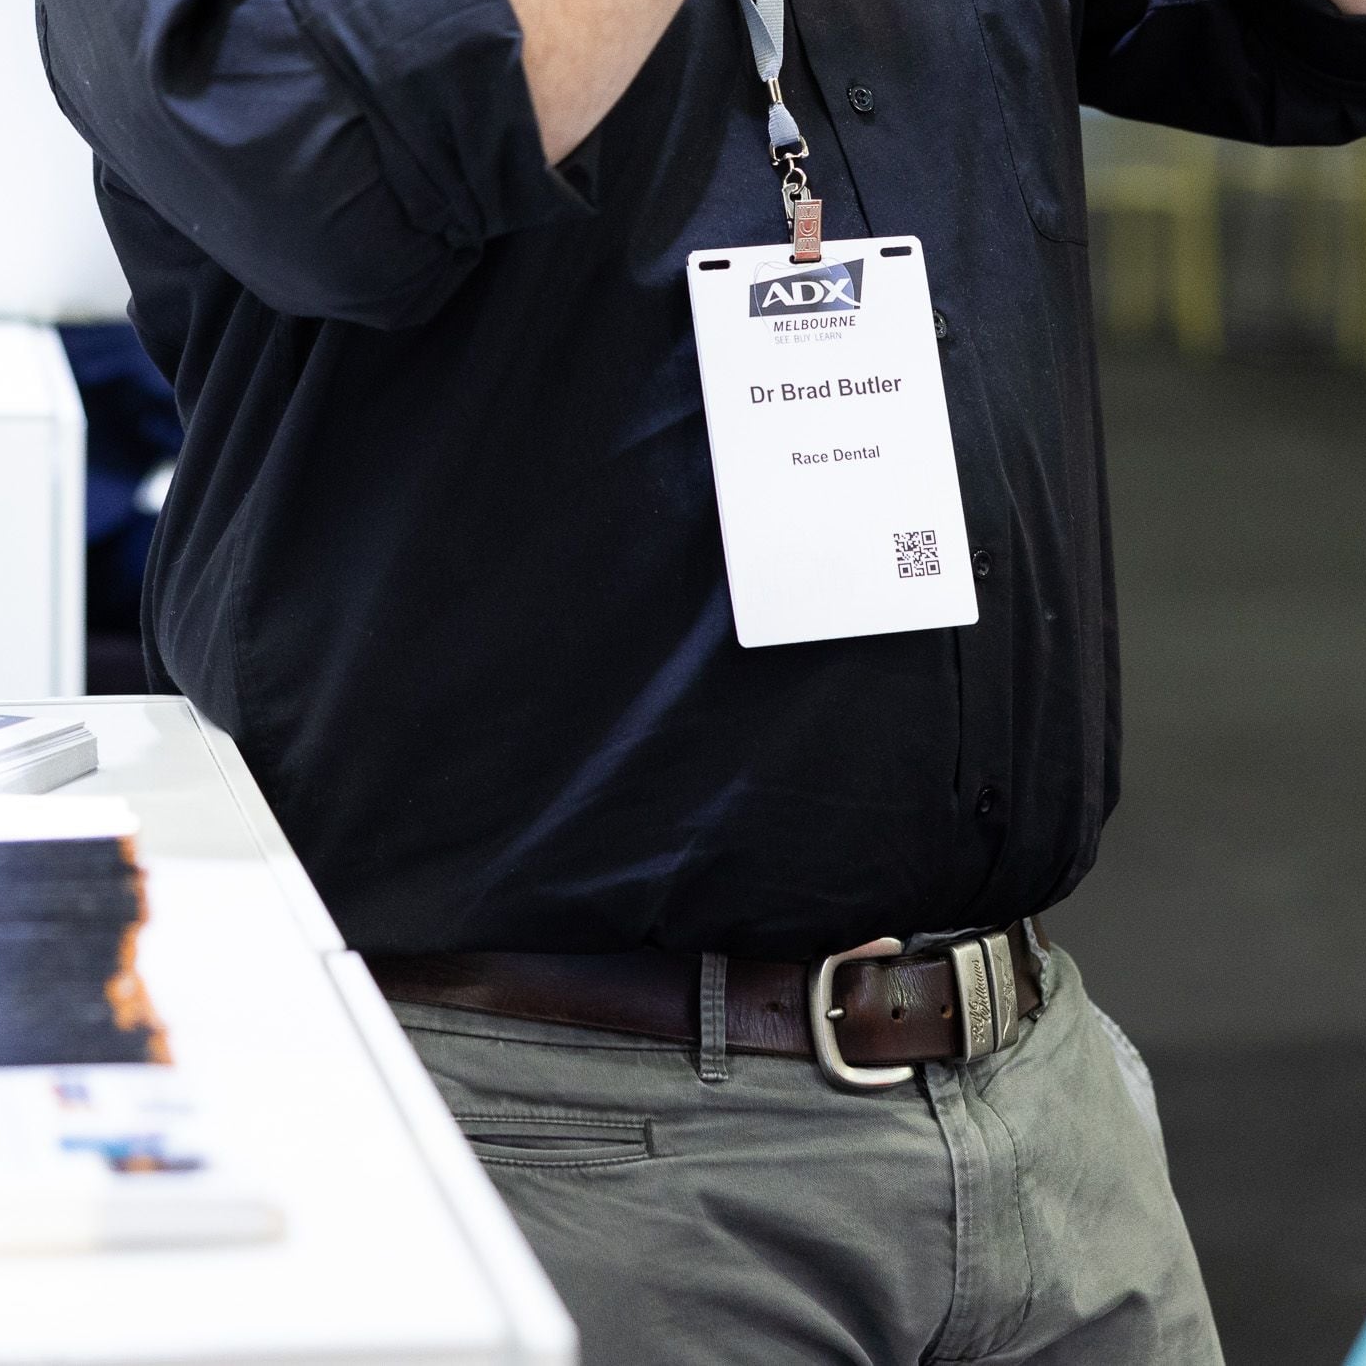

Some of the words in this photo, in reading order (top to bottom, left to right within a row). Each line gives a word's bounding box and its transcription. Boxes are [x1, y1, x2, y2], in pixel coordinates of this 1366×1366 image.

[761, 278, 863, 308] ADX
[773, 315, 856, 332] MELBOURNE
[774, 335, 793, 345] SEE
[794, 333, 812, 344] BUY
[814, 331, 842, 342] LEARN
[750, 385, 775, 404] Dr
[781, 380, 832, 402] Brad
[838, 375, 902, 397] Butler
[792, 450, 829, 466] Race
[832, 445, 881, 463] Dental
